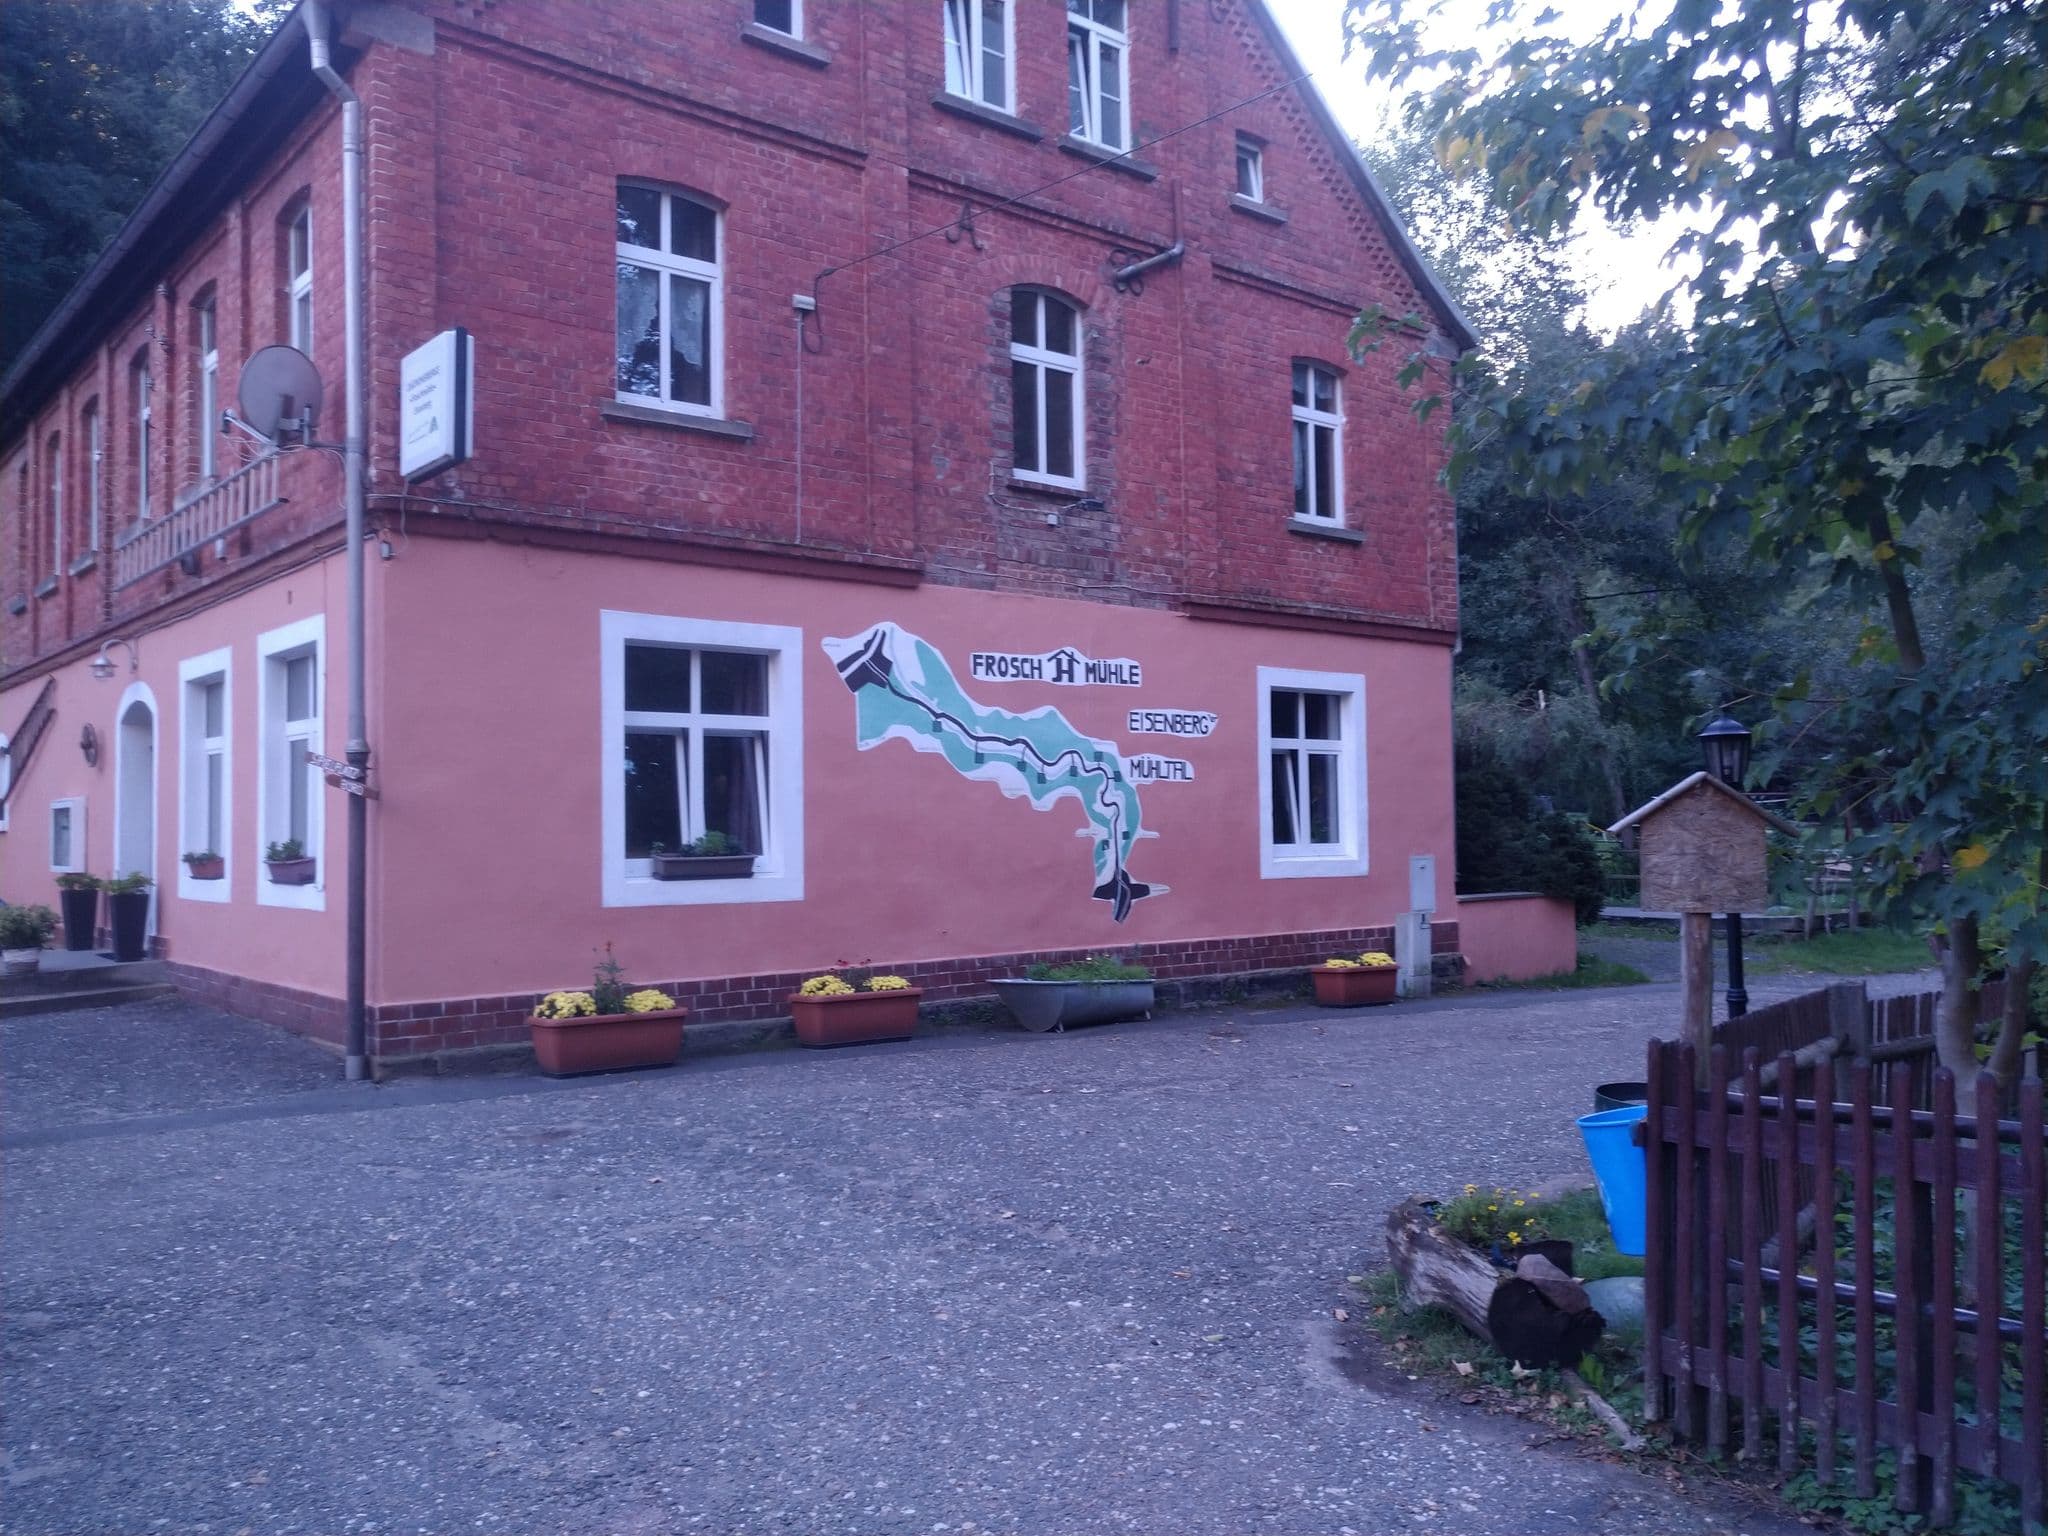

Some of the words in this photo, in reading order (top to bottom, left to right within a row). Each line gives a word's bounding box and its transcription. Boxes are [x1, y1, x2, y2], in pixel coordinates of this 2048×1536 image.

[972, 654, 1043, 679] FROSCH
[1085, 660, 1140, 685] MÜHLE
[1130, 755, 1193, 780] MÜHLTAL
